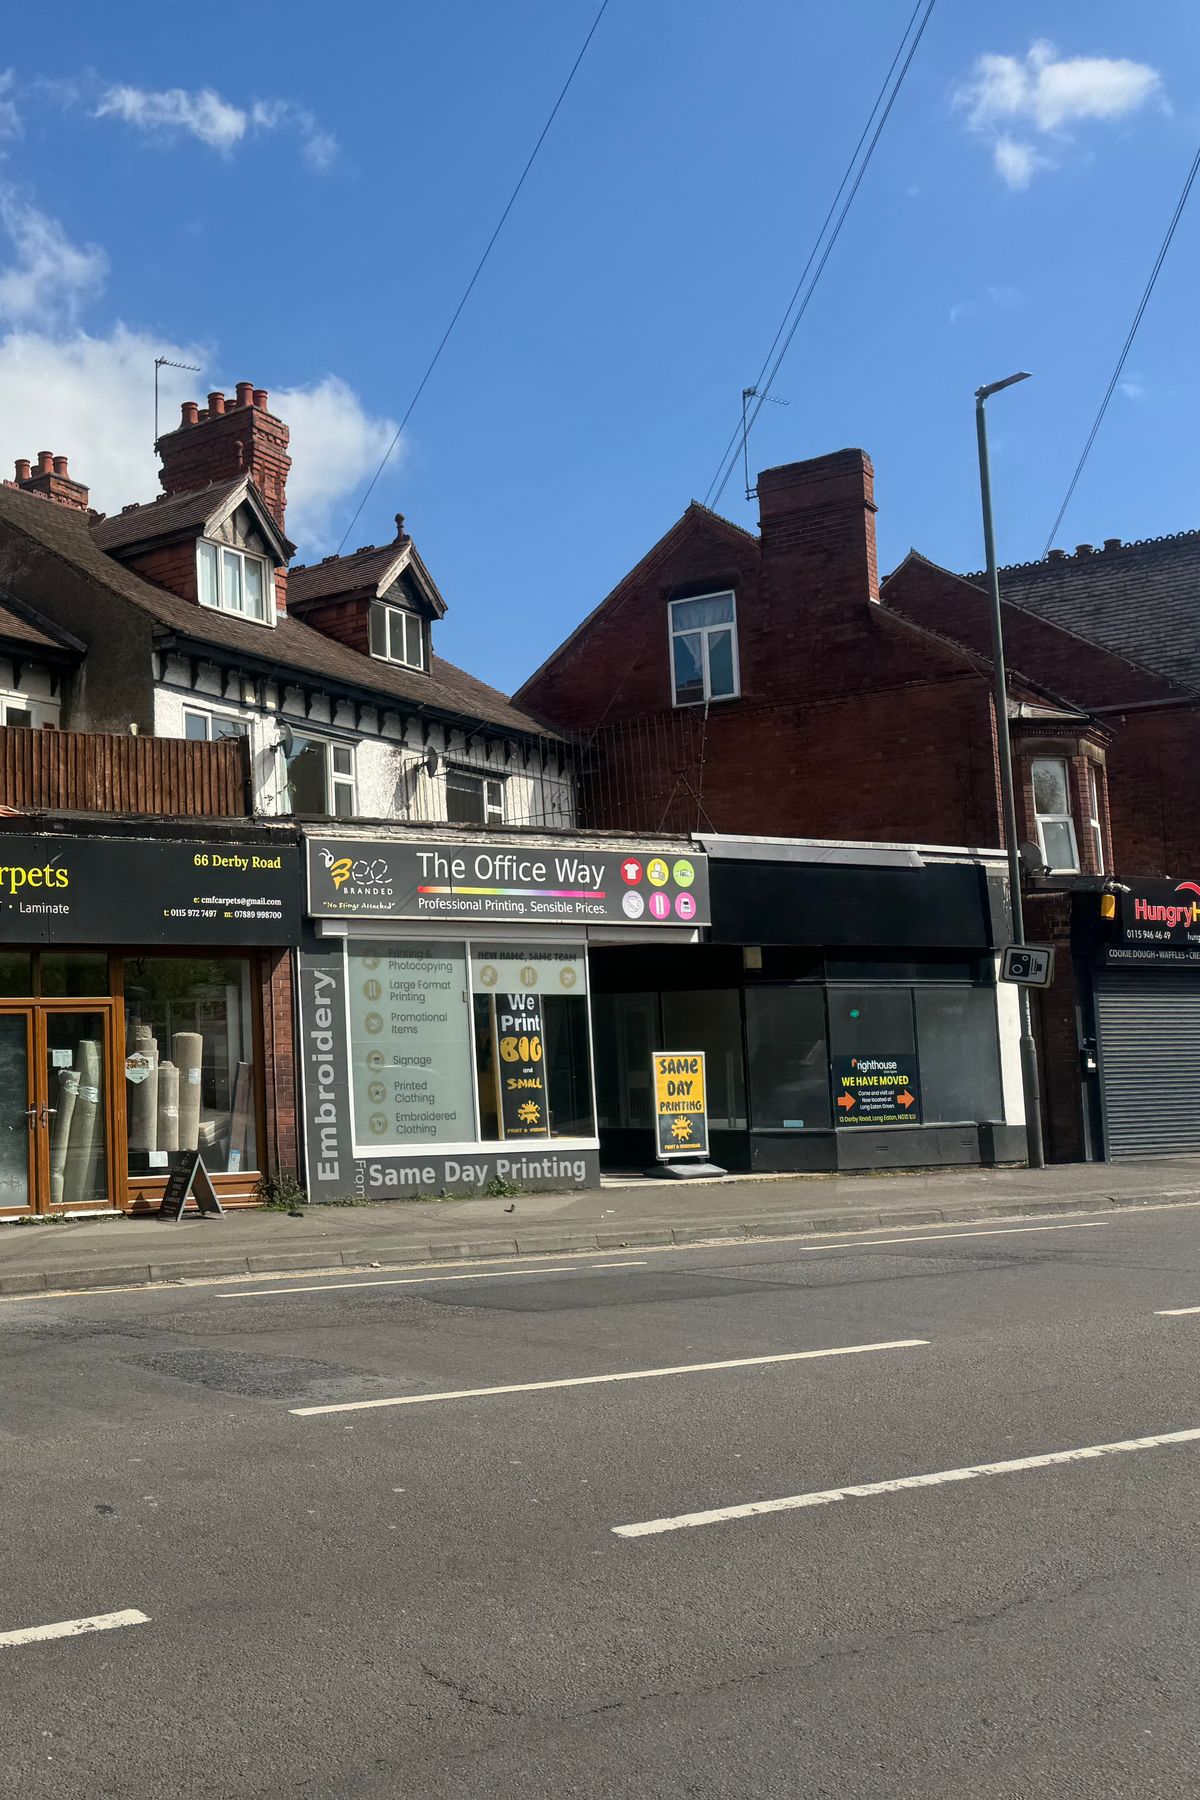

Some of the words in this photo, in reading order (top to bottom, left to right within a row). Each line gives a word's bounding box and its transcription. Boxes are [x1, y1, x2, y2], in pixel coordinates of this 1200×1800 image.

[194, 854, 209, 866] 66
[212, 854, 249, 871] Derby
[252, 856, 282, 869] Road
[416, 852, 466, 879] The
[474, 854, 546, 882] Office
[554, 858, 605, 890] Way
[343, 887, 393, 895] BRANDED
[19, 902, 70, 914] Laminate
[201, 896, 282, 907] cmfcarpets@gmail.com
[418, 897, 482, 911] Professional
[485, 899, 527, 914] Printing.
[530, 901, 573, 913] Sensible
[576, 902, 607, 914] Prices.
[170, 909, 186, 917] 0115
[187, 909, 200, 917] 972
[201, 909, 217, 918] 7497
[256, 911, 282, 919] 998700
[1126, 929, 1141, 939] 0115
[1143, 930, 1154, 939] 946
[1155, 931, 1162, 939] 46
[1164, 931, 1171, 940] 49
[388, 948, 423, 961] Printing
[1109, 949, 1132, 958] COOKIE
[1133, 949, 1155, 958] DOUGH
[1159, 950, 1185, 959] WAFFLES
[388, 960, 453, 974] Photocopying
[389, 980, 416, 992] Large
[418, 980, 451, 990] Format
[390, 992, 426, 1004] Printing
[507, 994, 535, 1010] We
[391, 1011, 448, 1022] Promotional
[501, 1012, 540, 1032] Print
[392, 1025, 418, 1034] Items
[500, 1036, 542, 1063] BIG
[393, 1055, 432, 1068] Signage
[857, 1060, 897, 1073] righthouse
[311, 970, 340, 1180] Embroidery
[841, 1077, 855, 1087] WE
[856, 1076, 878, 1086] HAVE
[879, 1075, 909, 1085] MOVED
[394, 1080, 428, 1091] Printed
[506, 1076, 543, 1090] SMALL
[667, 1080, 694, 1097] DAY
[395, 1093, 435, 1105] Clothing
[660, 1100, 702, 1112] PRINTING
[395, 1111, 457, 1122] Embroidered
[396, 1123, 437, 1136] Clothing
[369, 1164, 436, 1187] Same
[444, 1161, 488, 1187] Day
[496, 1156, 586, 1182] Printing
[354, 1160, 367, 1198] From
